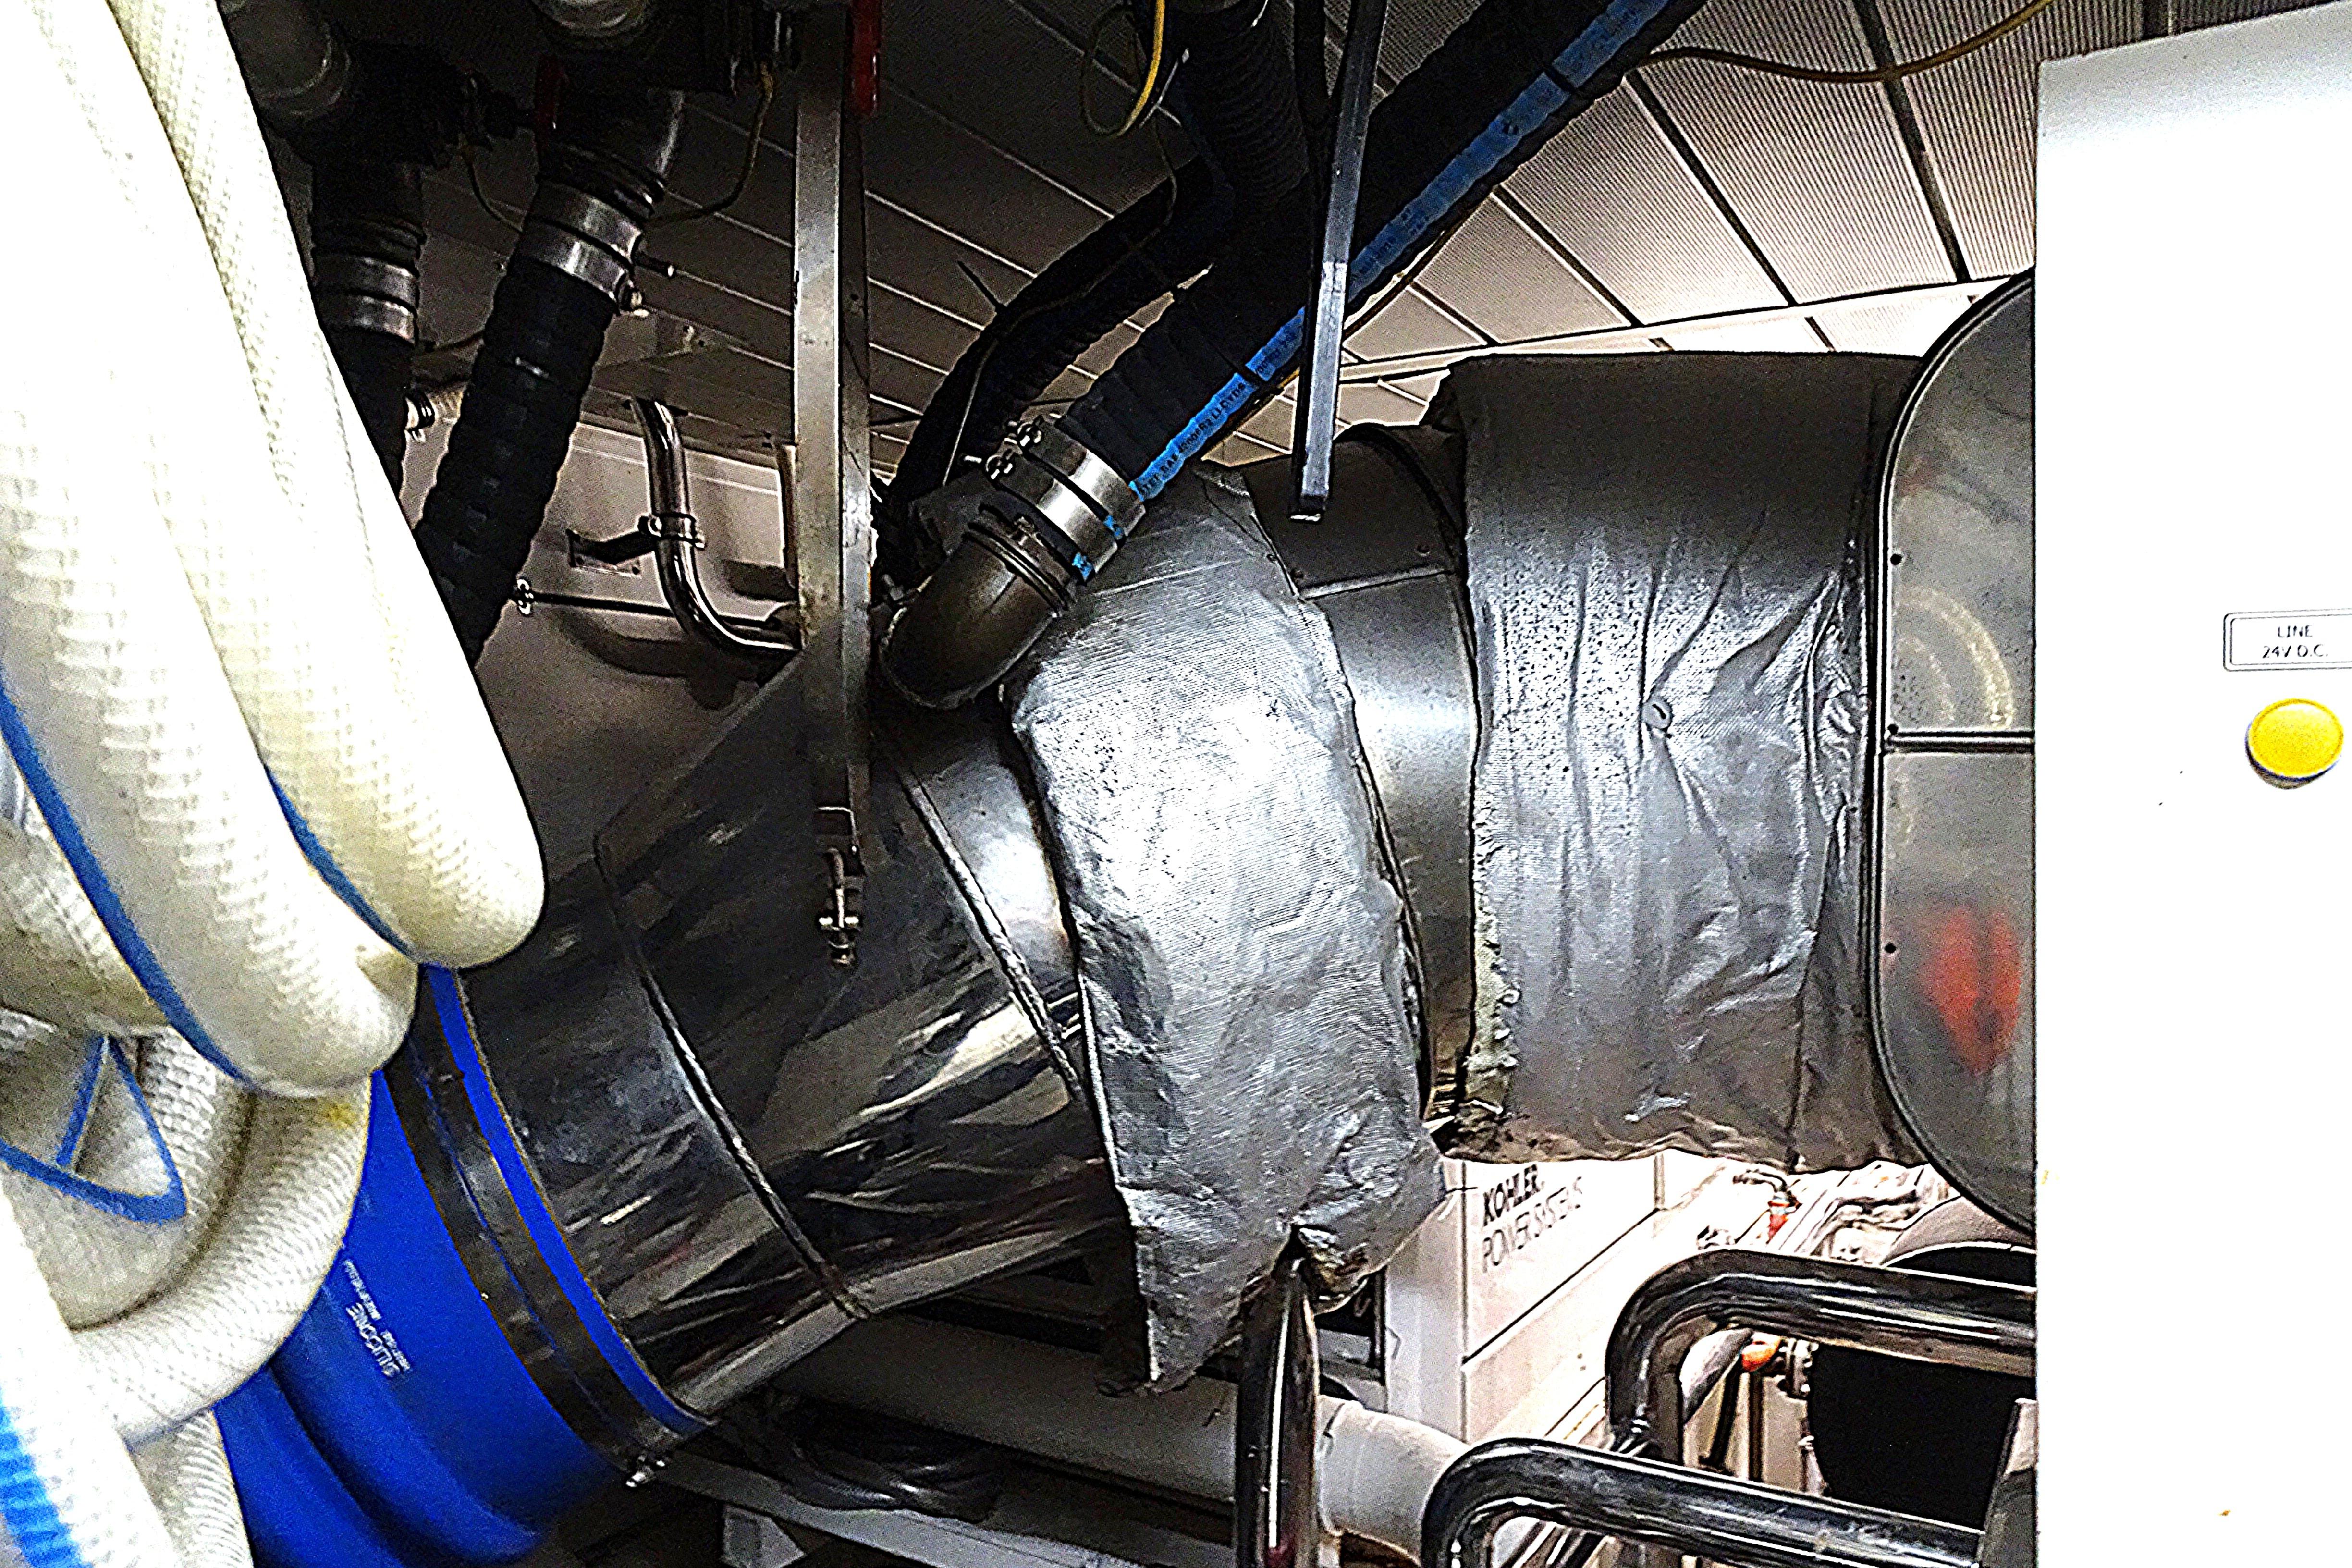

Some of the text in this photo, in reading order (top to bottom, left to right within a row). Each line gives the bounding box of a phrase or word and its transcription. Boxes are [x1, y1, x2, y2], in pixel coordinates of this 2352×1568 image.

[2262, 645, 2292, 659] 24V
[2277, 624, 2313, 638] LINE
[1482, 1164, 1541, 1227] KOHLER
[1533, 1176, 1583, 1238] SYSTES
[345, 1302, 401, 1378] SILICONE
